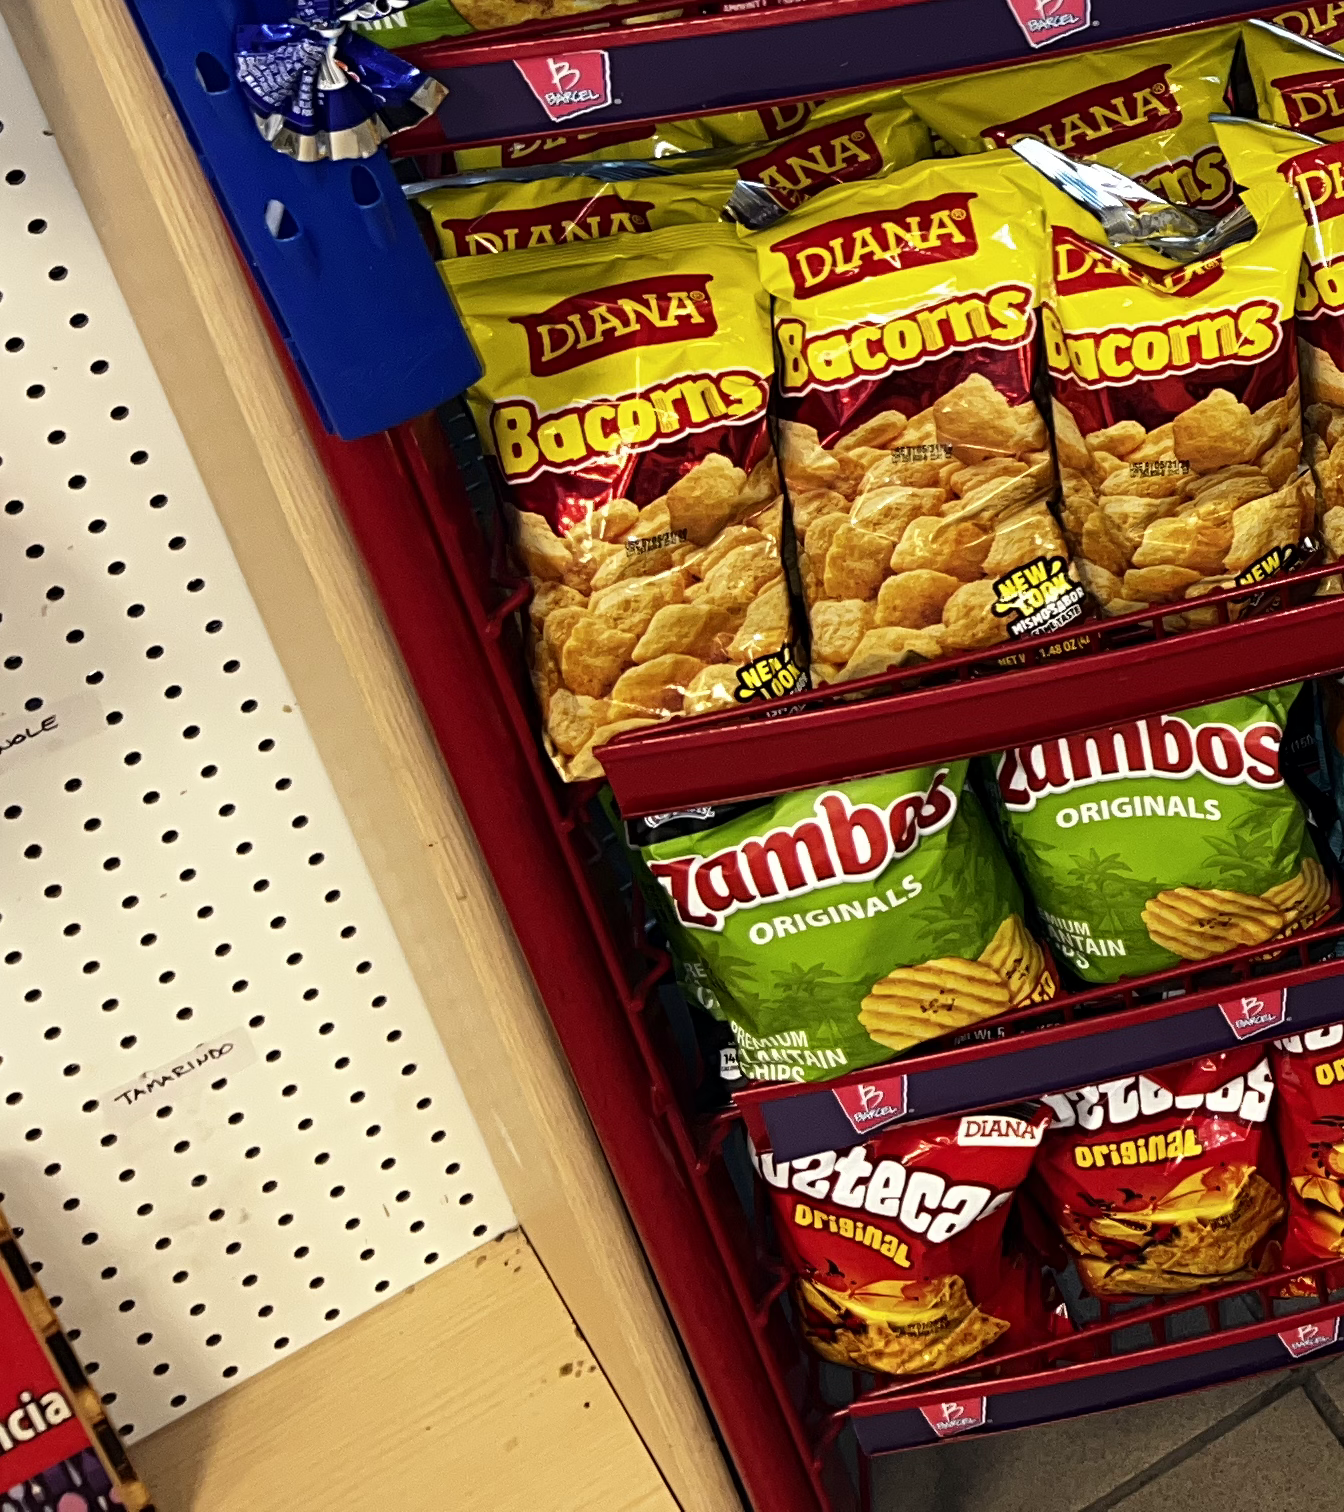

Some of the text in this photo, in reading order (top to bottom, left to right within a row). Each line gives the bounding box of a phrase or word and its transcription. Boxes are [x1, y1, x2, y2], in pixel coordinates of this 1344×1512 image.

[1026, 13, 1080, 33] BARCEL
[544, 88, 600, 107] BARCEL
[796, 208, 967, 288] DIANA
[539, 290, 705, 367] DIANA
[778, 288, 1030, 388] Bacorns
[1042, 305, 1274, 381] Bacorns
[494, 372, 768, 476] Bacorns
[998, 561, 1047, 597] NEW
[1055, 795, 1222, 829] ORIGINALS
[748, 874, 924, 945] ORIGINALS
[113, 1041, 236, 1108] TAMARINDO
[965, 1117, 1036, 1142] DIANA
